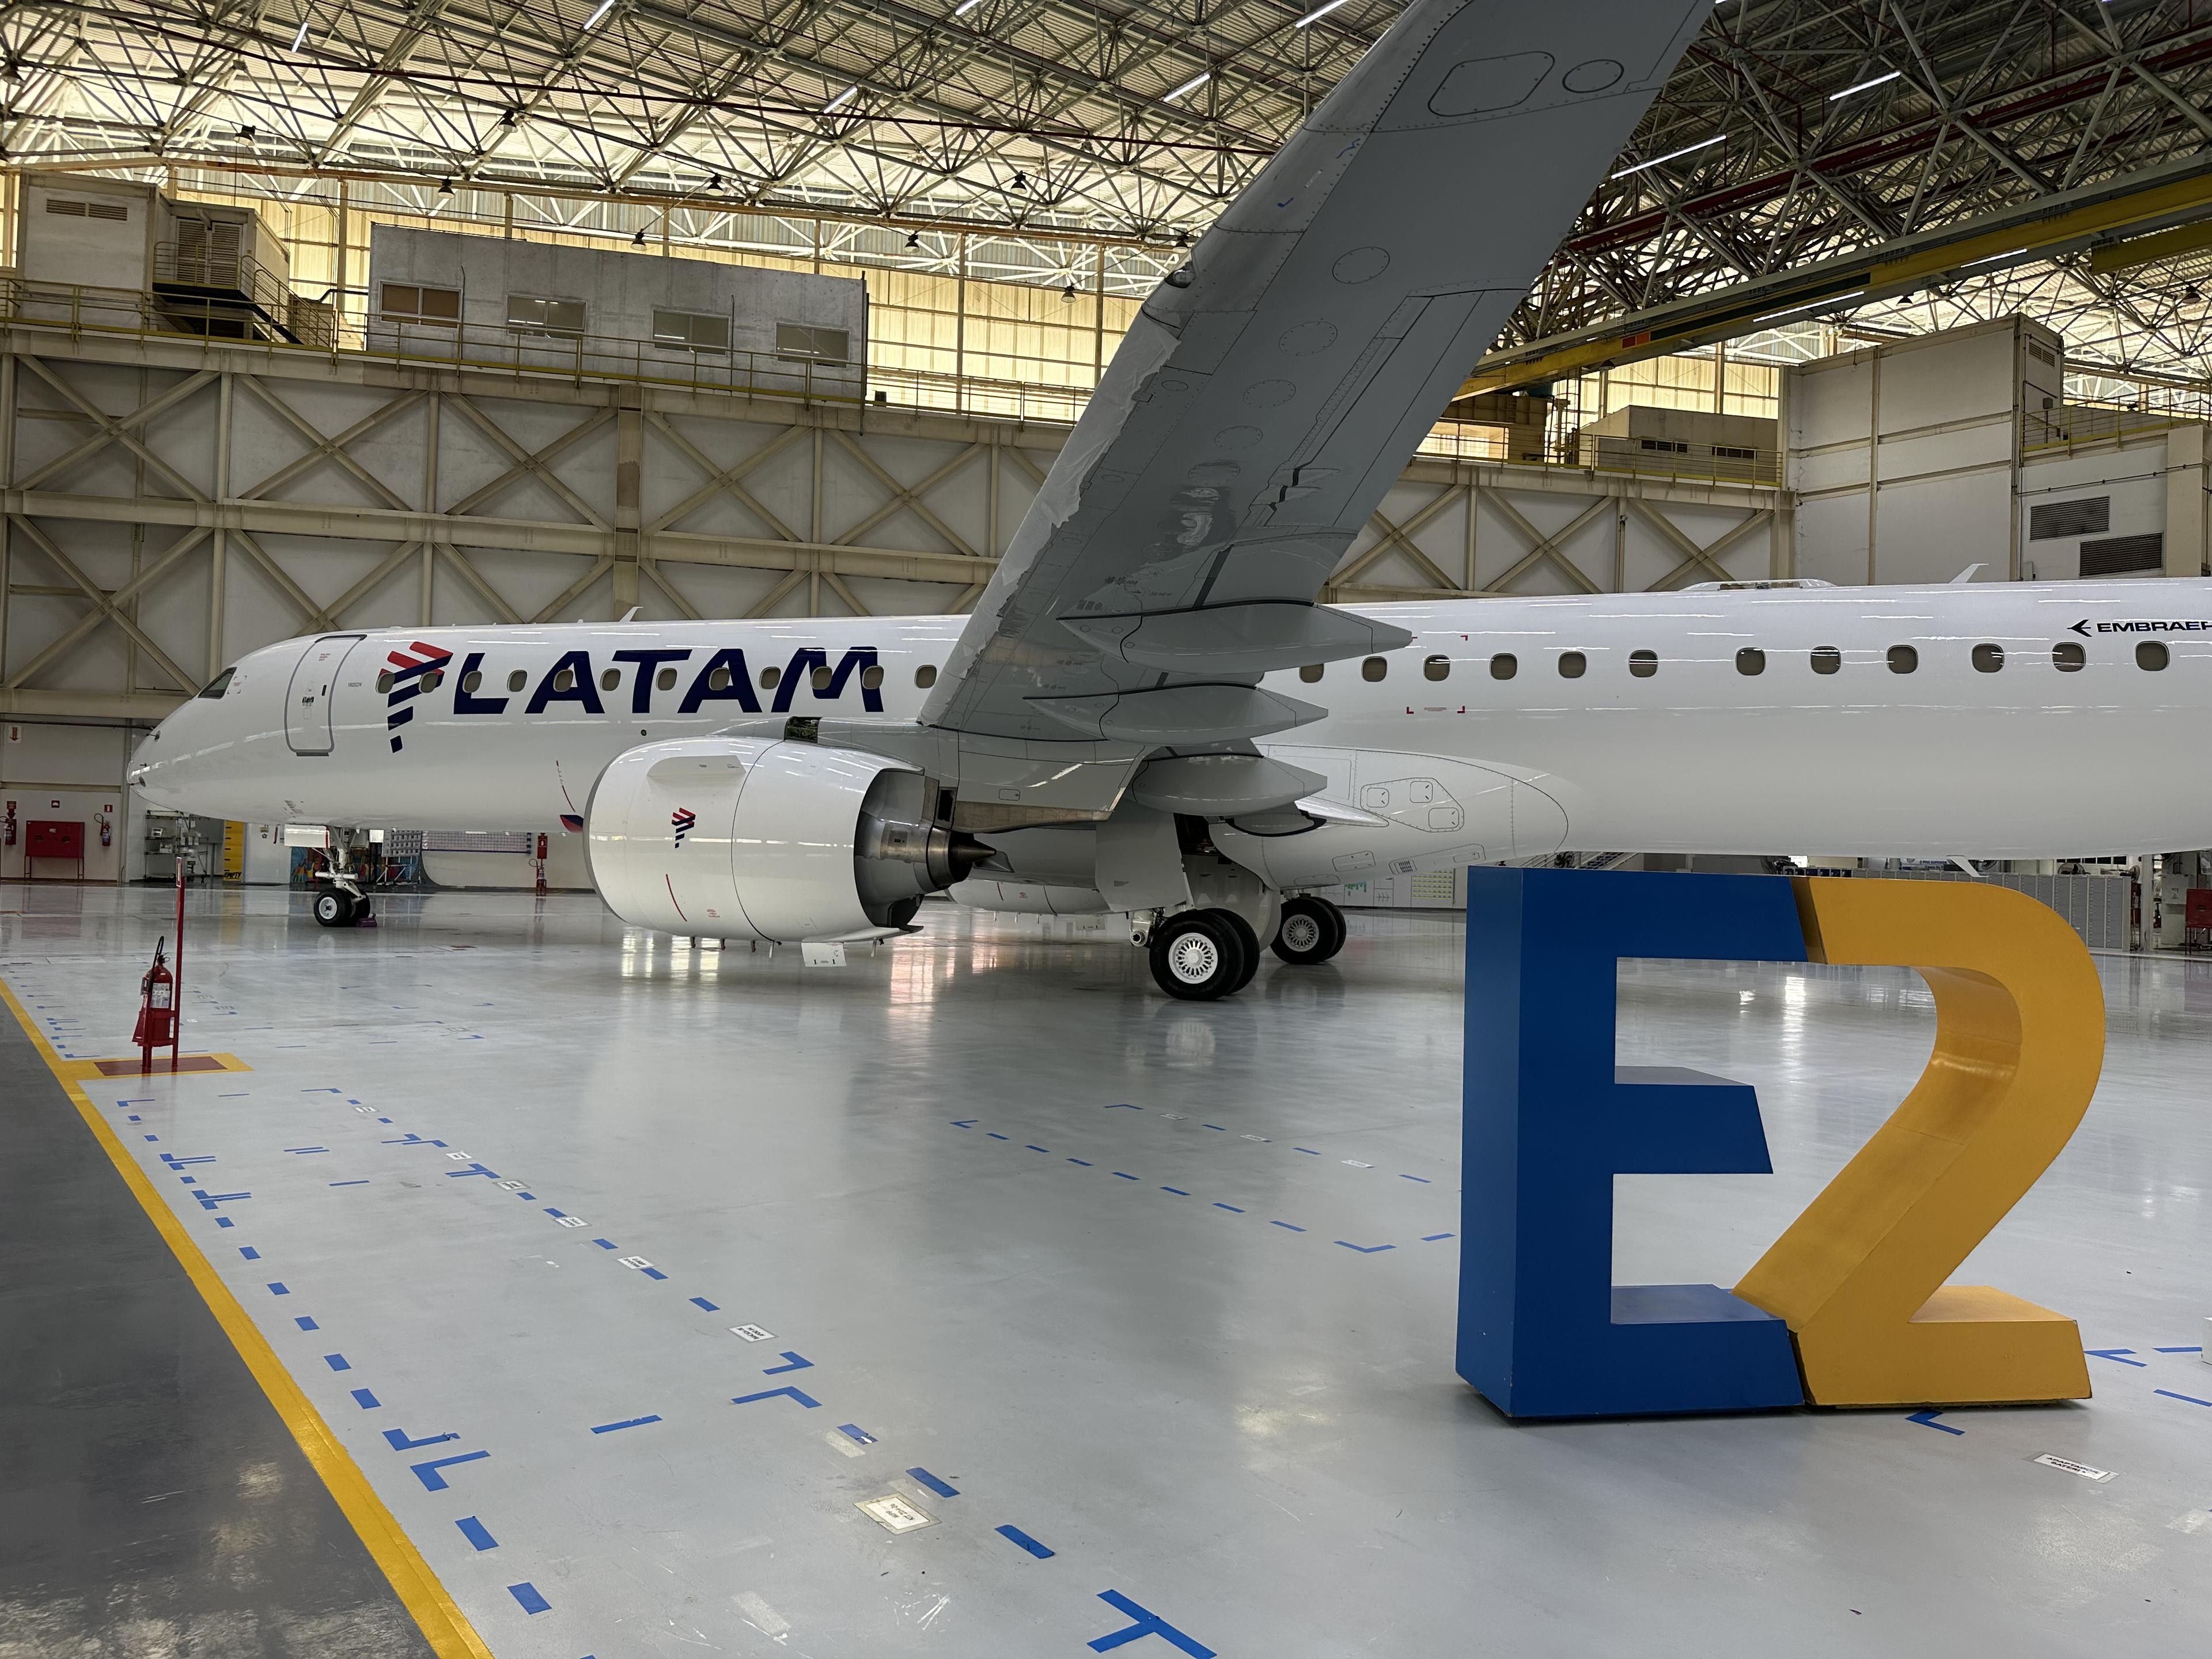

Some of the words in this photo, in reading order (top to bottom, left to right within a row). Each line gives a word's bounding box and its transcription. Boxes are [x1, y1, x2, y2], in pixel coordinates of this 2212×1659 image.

[453, 646, 884, 714] LATAM
[1456, 866, 2105, 1420] E2
[2046, 1457, 2100, 1475] ADAPTADOR
